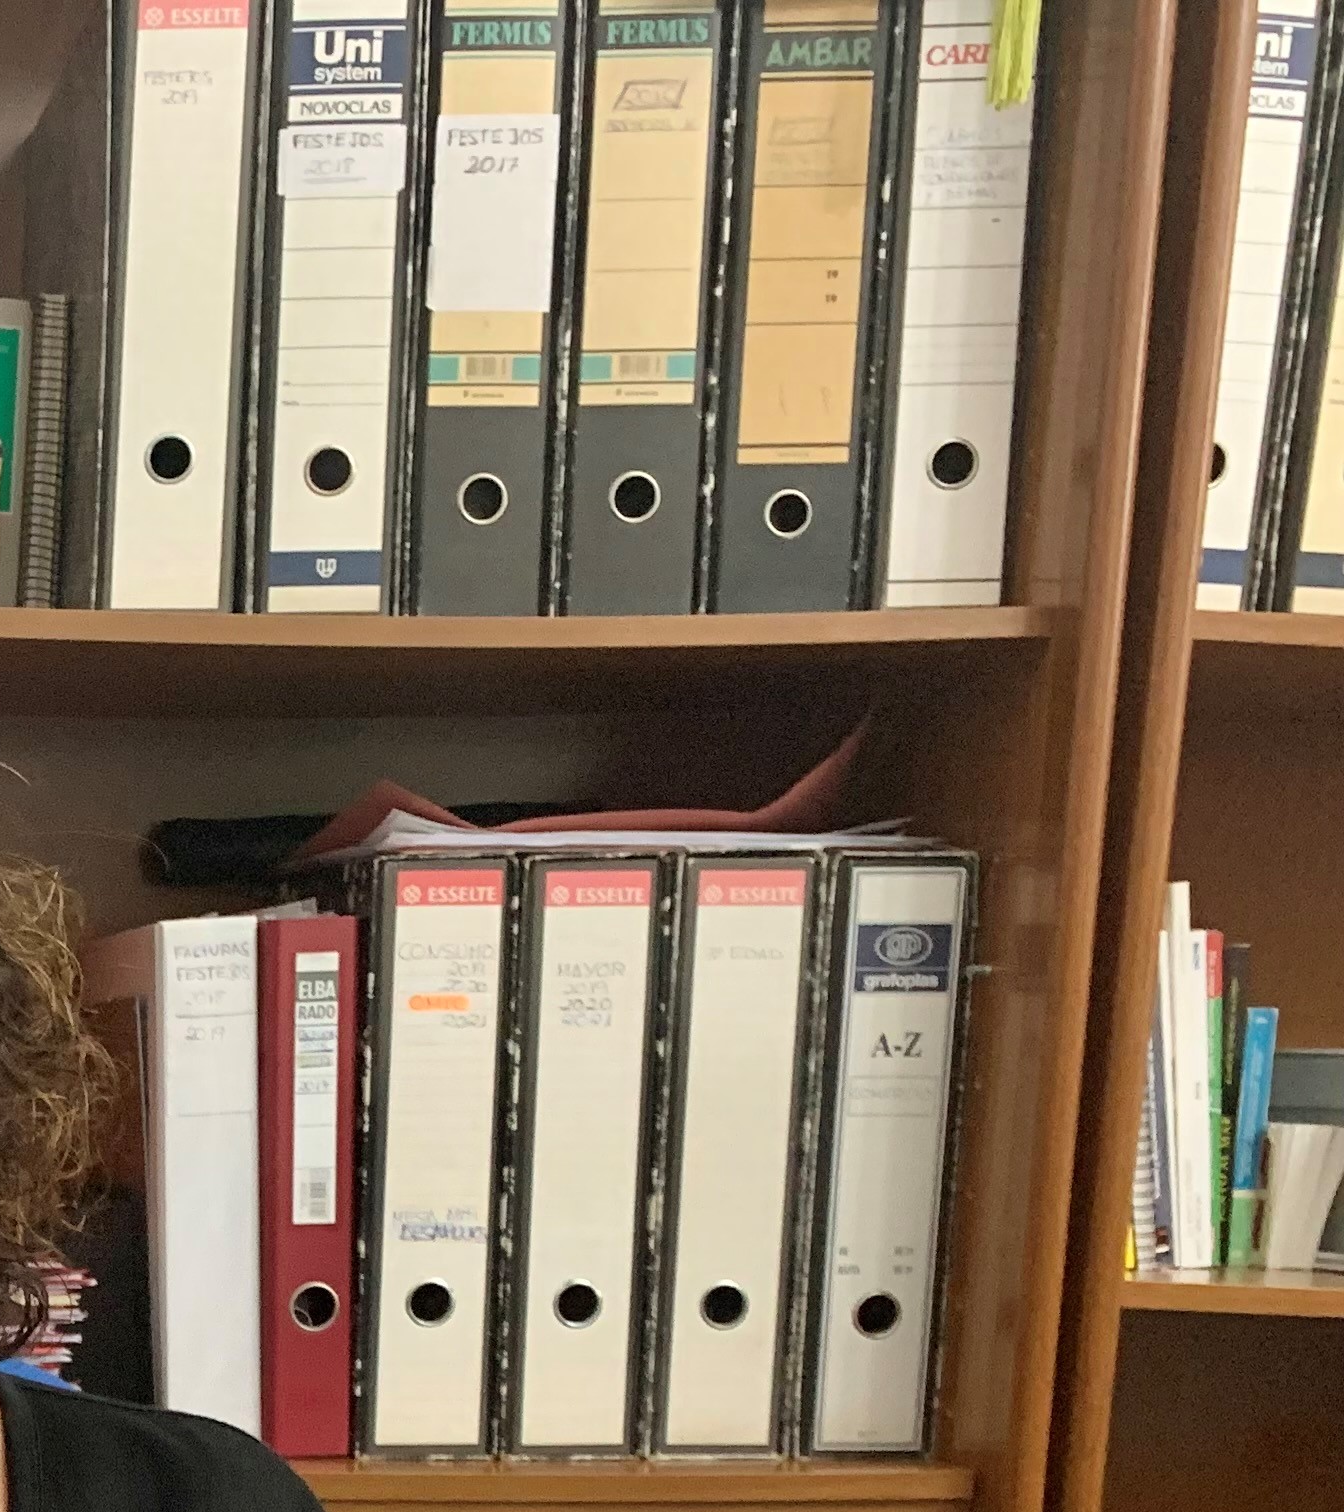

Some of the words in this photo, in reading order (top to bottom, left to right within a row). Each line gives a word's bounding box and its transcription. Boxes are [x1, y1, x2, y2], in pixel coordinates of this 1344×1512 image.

[171, 8, 242, 24] ESSELTE
[450, 21, 551, 46] FERMUS
[606, 18, 709, 44] FERMUS
[314, 30, 384, 65] Uni
[766, 36, 873, 68] AMBAR
[1255, 26, 1293, 59] ni
[314, 64, 382, 85] system
[299, 99, 392, 116] NOVOCLAS
[292, 131, 385, 150] FESTEJOS
[447, 128, 545, 148] FESTEJOS
[428, 885, 497, 903] ESSELTE
[575, 885, 646, 903] ESSELTE
[729, 885, 800, 903] ESSELTE
[174, 941, 250, 959] FACTURAS
[399, 942, 494, 960] CONSUMO
[557, 962, 626, 978] MAYOR
[298, 981, 337, 1000] ELBA
[298, 1004, 337, 1021] RADO
[870, 1031, 923, 1059] A-Z
